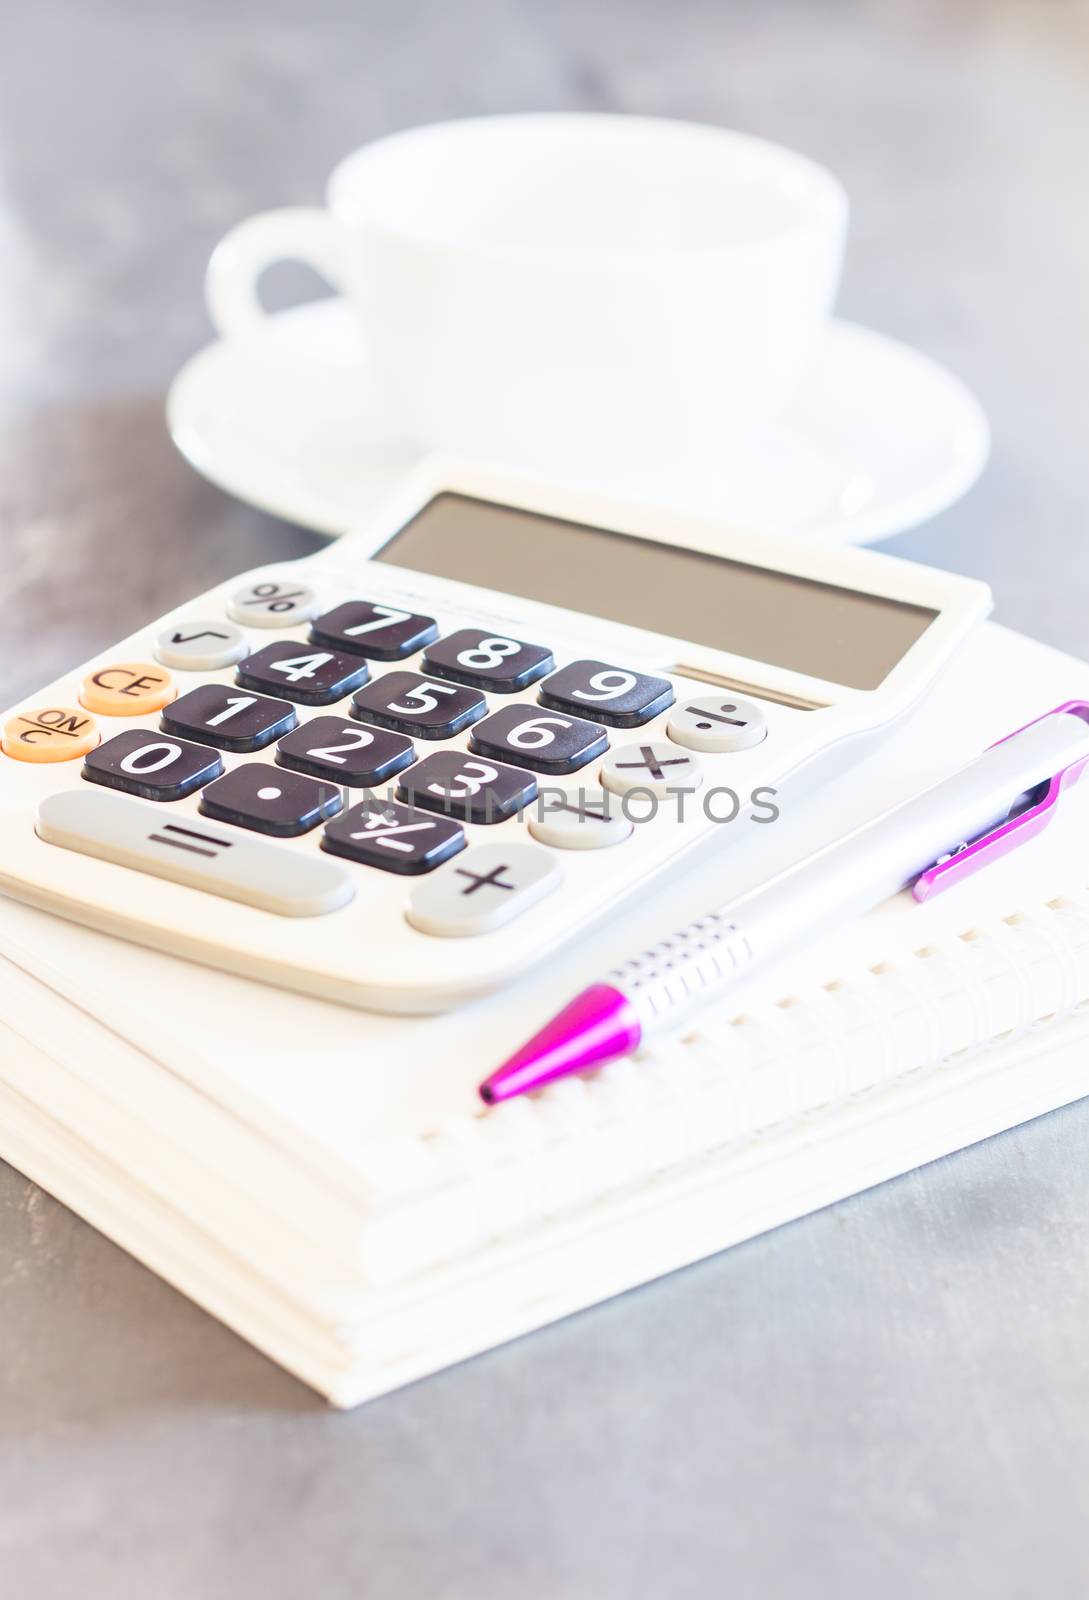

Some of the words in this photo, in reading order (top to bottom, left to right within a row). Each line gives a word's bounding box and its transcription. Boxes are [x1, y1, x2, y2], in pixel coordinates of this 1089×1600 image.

[343, 606, 412, 636] 7
[270, 652, 334, 682] 4
[456, 637, 521, 669] 8
[92, 669, 163, 697] CE
[571, 671, 637, 701] 9
[205, 697, 258, 727] 1
[387, 682, 457, 715] 5
[20, 729, 51, 744] C
[37, 710, 90, 733] ON
[506, 718, 573, 749] 6
[120, 742, 182, 774] 0
[306, 728, 374, 764] 2
[427, 762, 498, 798] 3
